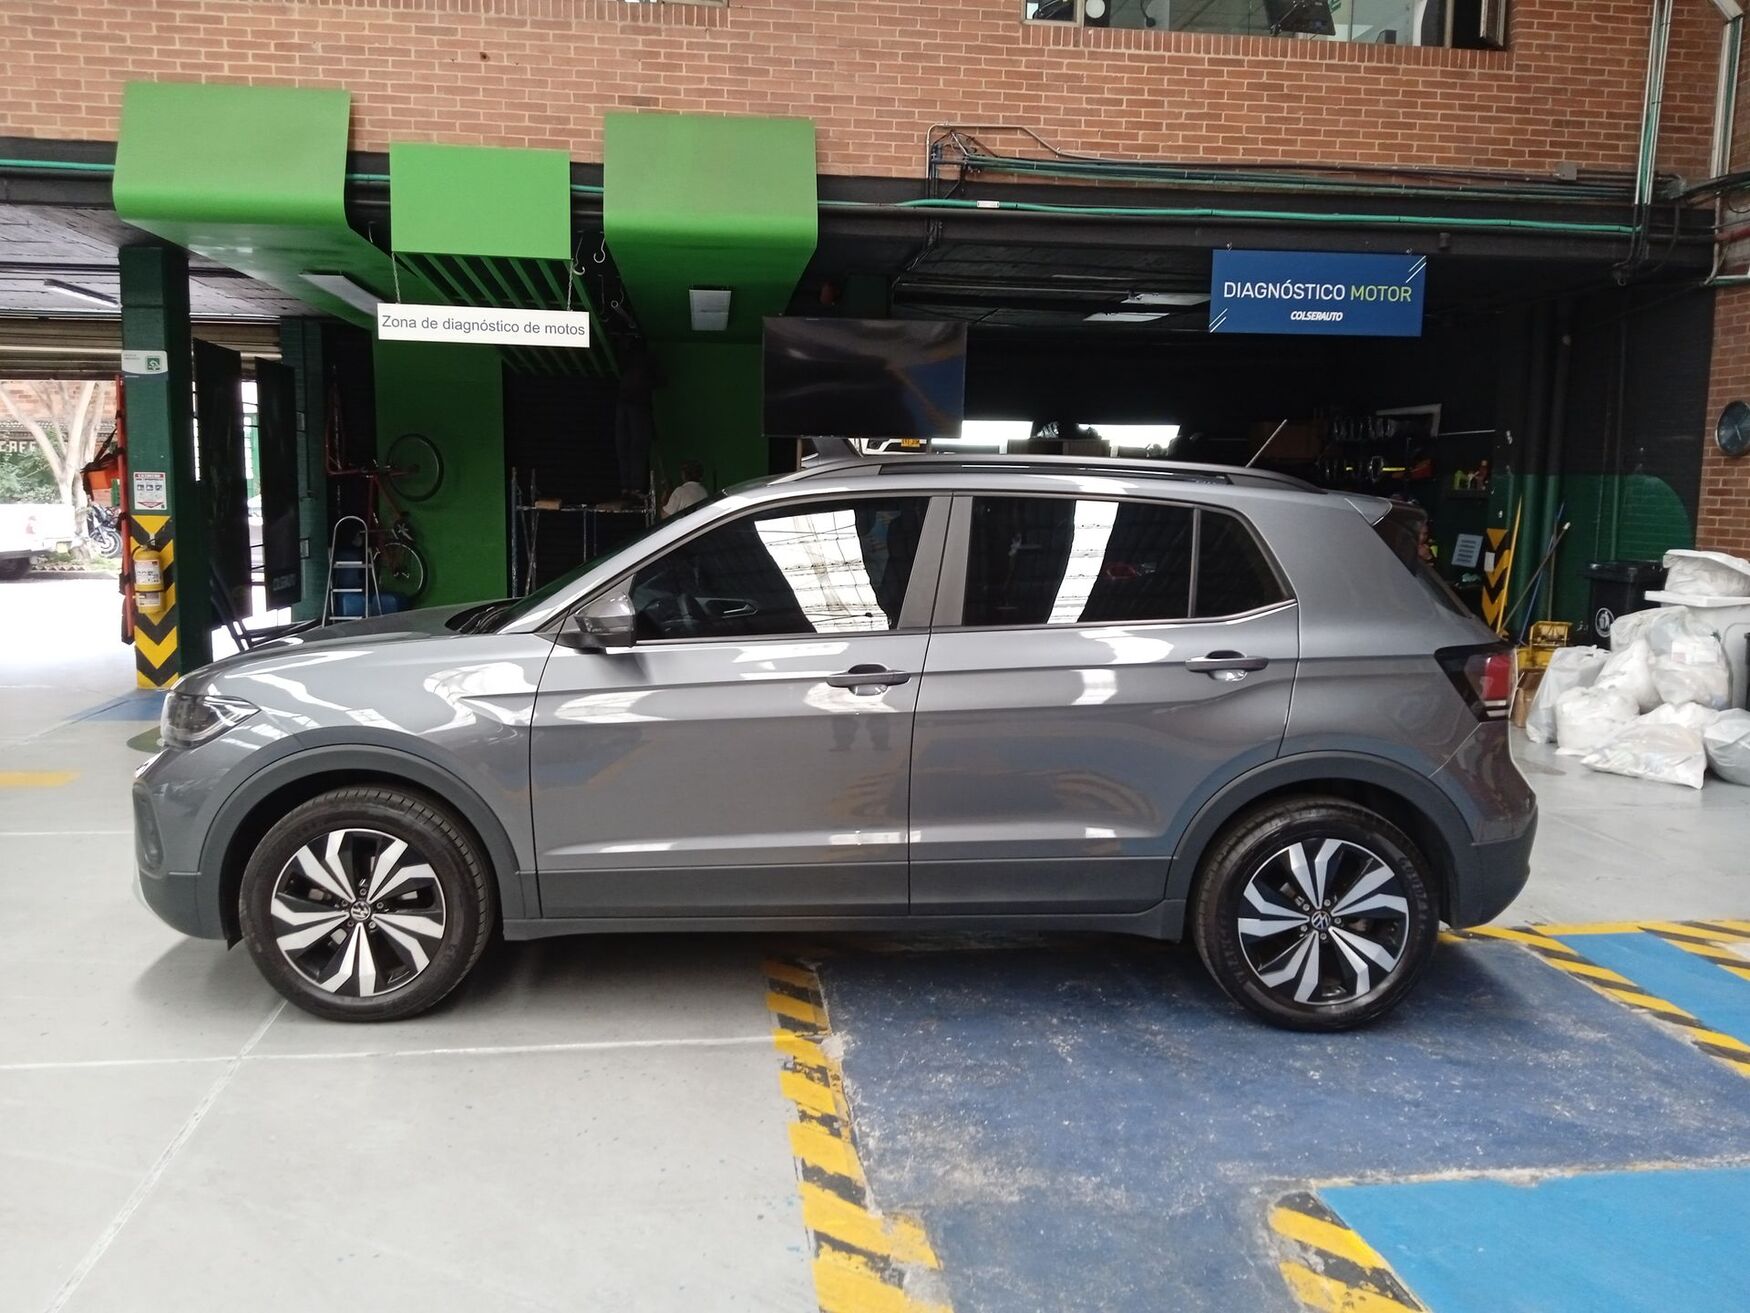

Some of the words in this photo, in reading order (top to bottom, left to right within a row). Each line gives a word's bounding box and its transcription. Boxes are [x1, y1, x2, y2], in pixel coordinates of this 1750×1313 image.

[1224, 279, 1346, 300] DIAGNÓSTICO
[1350, 285, 1412, 302] MOTOR
[382, 315, 417, 328] Zona
[421, 317, 438, 329] de
[442, 318, 519, 333] diagnóstico
[523, 321, 540, 333] de
[545, 323, 585, 335] motos
[1290, 310, 1344, 321] COLSERAUTO
